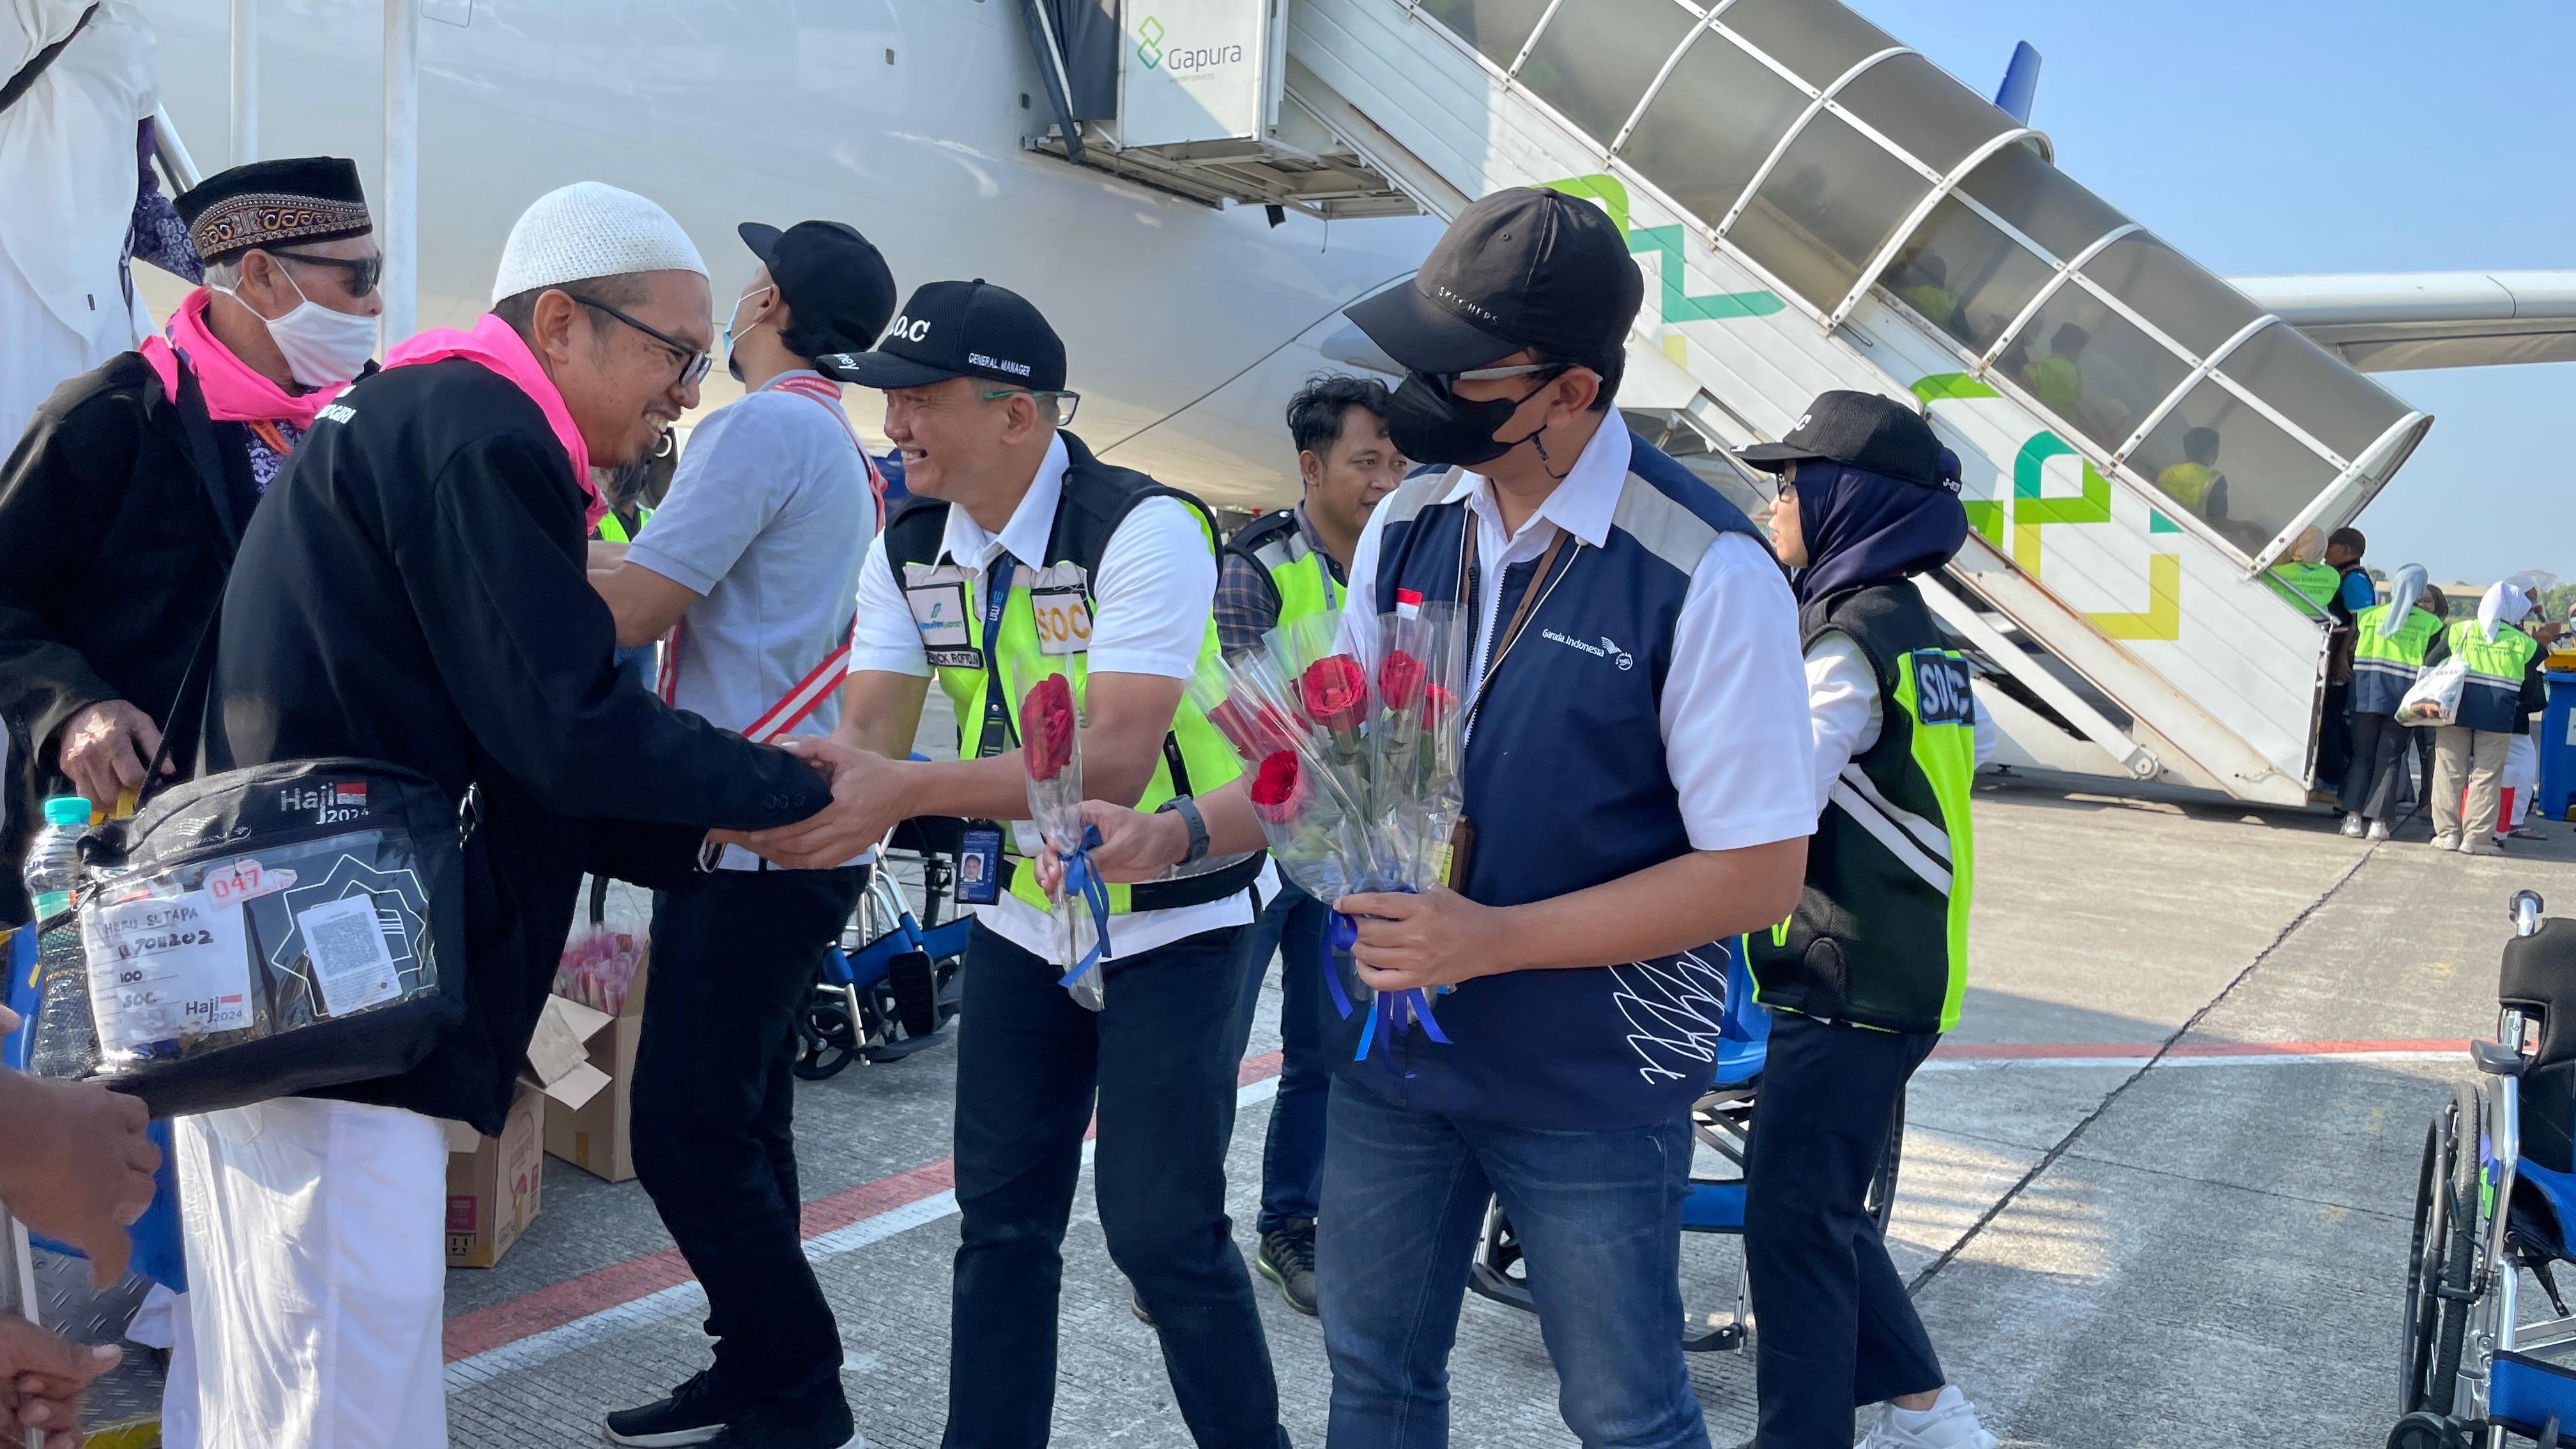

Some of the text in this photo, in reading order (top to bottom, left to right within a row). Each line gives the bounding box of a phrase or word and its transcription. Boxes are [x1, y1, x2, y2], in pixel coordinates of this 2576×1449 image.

[1169, 45, 1241, 73] Gapura
[969, 353, 1031, 377] GENERAL MANAGER
[1036, 604, 1091, 642] SOC
[1542, 628, 1565, 643] Garuda
[1566, 635, 1605, 657] Indonesia
[280, 781, 335, 824] Haji
[211, 868, 259, 898] 047
[119, 970, 143, 983] 100
[123, 991, 157, 1009] SOC
[185, 996, 219, 1023] Haji
[213, 1009, 242, 1022] 2024
